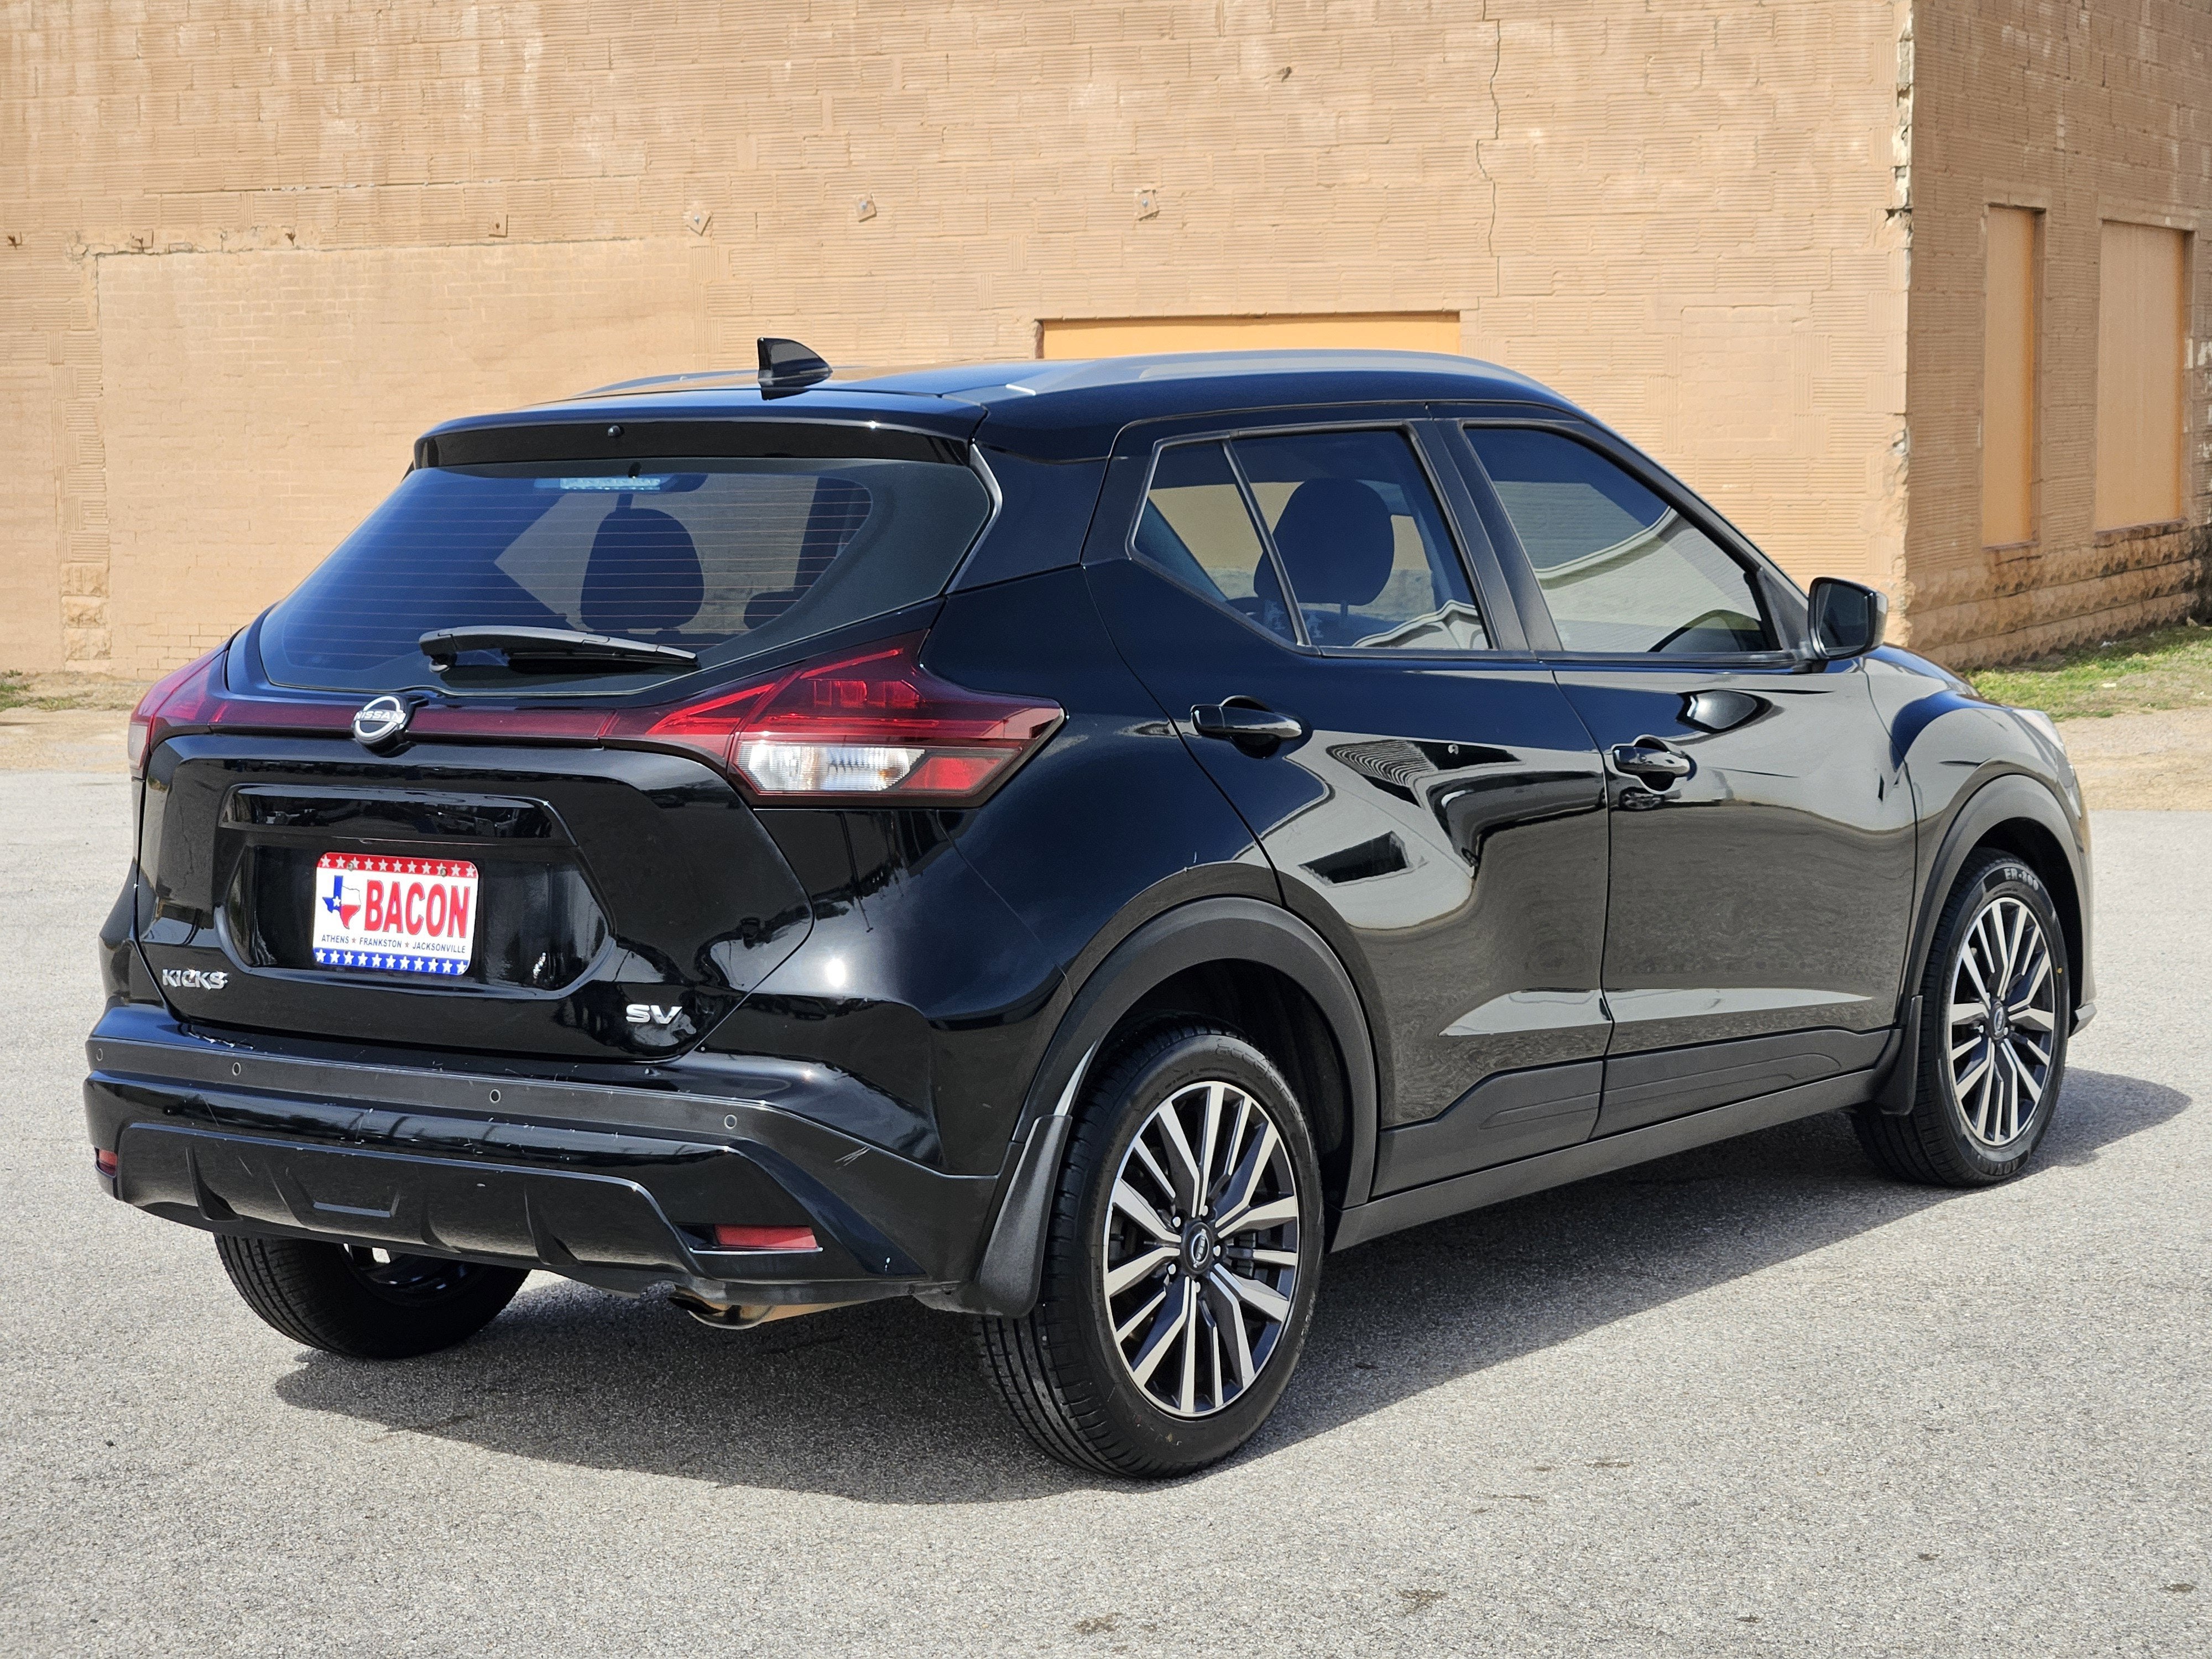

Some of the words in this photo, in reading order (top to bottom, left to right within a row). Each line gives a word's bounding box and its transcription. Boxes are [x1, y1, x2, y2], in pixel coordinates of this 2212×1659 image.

[353, 710, 406, 724] NISSAN
[364, 879, 471, 938] BACON
[321, 935, 349, 944] ATHENS
[359, 937, 402, 948] FRANKSTON
[413, 942, 466, 953] JACKSONVILLE
[162, 969, 227, 990] KICKS
[625, 1004, 683, 1024] SV
